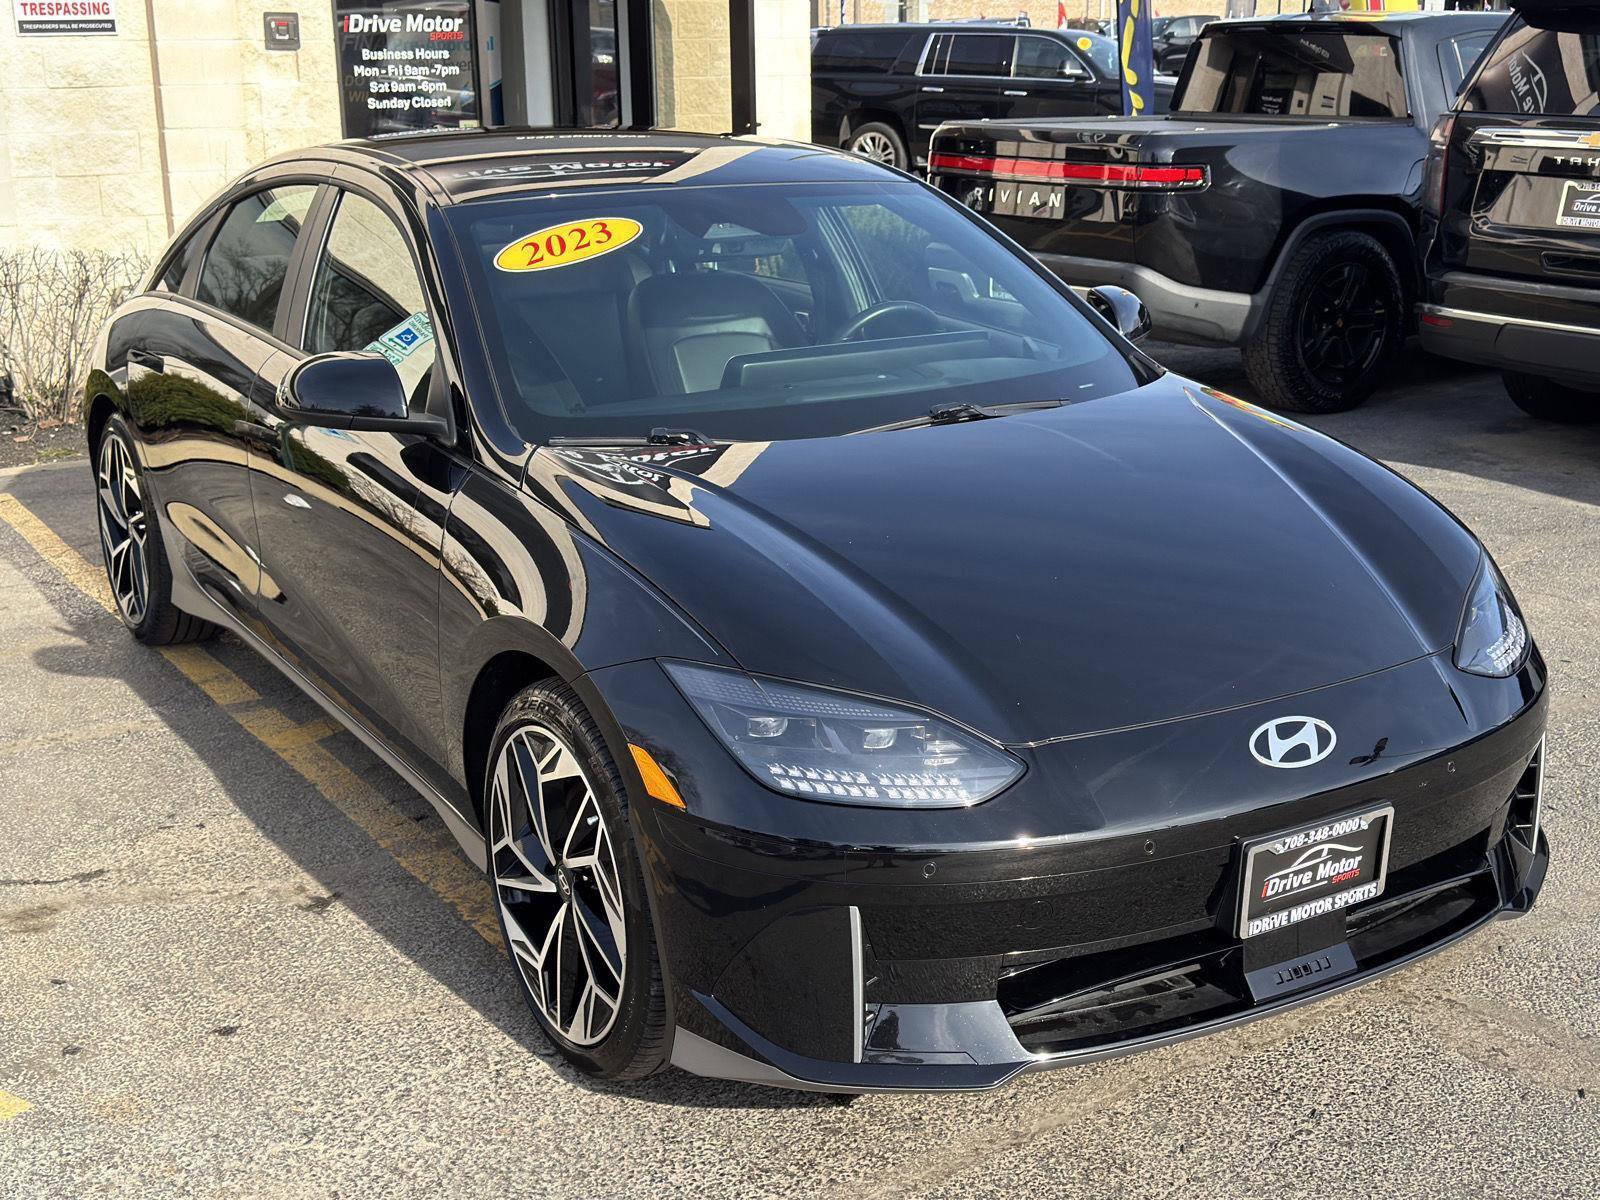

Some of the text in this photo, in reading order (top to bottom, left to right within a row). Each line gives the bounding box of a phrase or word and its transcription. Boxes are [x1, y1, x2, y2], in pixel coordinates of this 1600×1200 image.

[20, 2, 110, 16] TRESPASSING
[343, 14, 463, 33] iDrive Motor
[429, 31, 464, 41] SPORTS
[361, 48, 450, 61] Business Hours
[353, 65, 380, 77] Mon
[404, 64, 430, 76] 9am
[390, 82, 417, 93] 9am
[367, 97, 411, 111] Sunday
[972, 187, 1063, 208] RIVIAN
[521, 222, 613, 267] 2023
[1283, 818, 1360, 851] 708-348-0000
[1261, 855, 1363, 898] iDrive Motor
[1331, 868, 1361, 885] SPORTS
[1290, 899, 1333, 923] MOTOR
[1334, 882, 1378, 909] SPORTS
